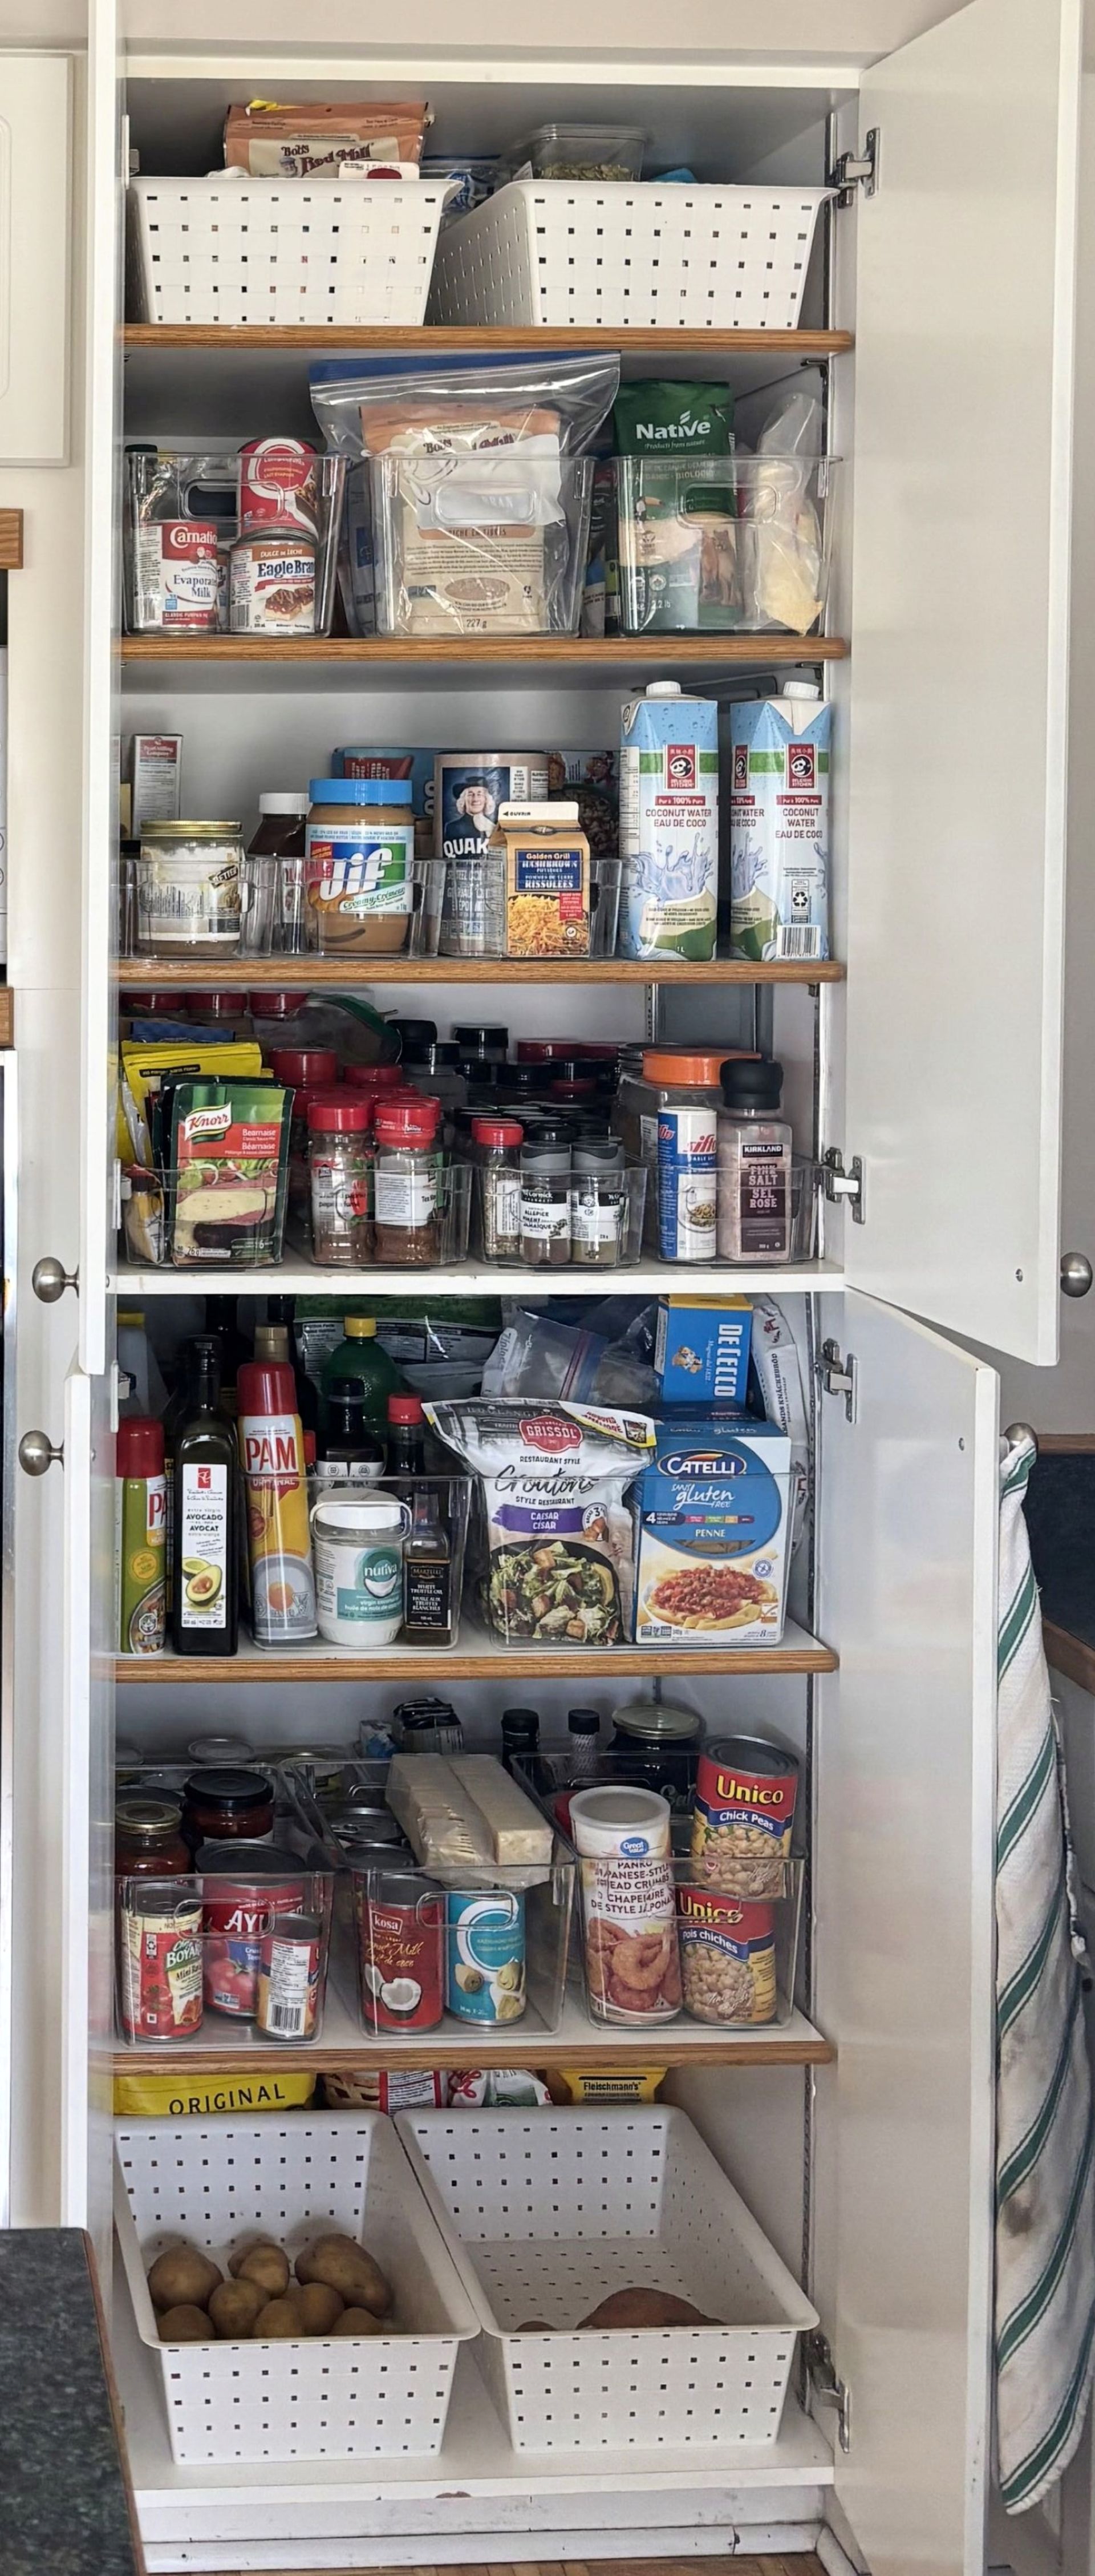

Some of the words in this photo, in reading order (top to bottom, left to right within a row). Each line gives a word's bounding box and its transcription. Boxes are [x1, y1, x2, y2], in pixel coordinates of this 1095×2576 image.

[281, 145, 309, 156] Bob's
[301, 153, 334, 176] Red
[336, 143, 373, 162] Mill
[636, 418, 711, 439] Native
[257, 562, 293, 579] Eagle
[192, 586, 212, 597] Milk
[467, 618, 480, 627] 227
[320, 848, 392, 900] Jif
[188, 1114, 229, 1131] Knorr
[749, 1175, 778, 1186] SALT
[752, 1188, 774, 1198] SEL
[749, 1199, 777, 1208] ROSE
[718, 1324, 743, 1345] DE
[714, 1348, 741, 1396] CECCO
[526, 1426, 578, 1439] GRISSOL
[245, 1437, 296, 1471] PAM
[667, 1457, 735, 1474] CATELLI
[516, 1496, 536, 1505] STYLE
[673, 1484, 735, 1511] gluten
[531, 1512, 559, 1520] CAESAR
[646, 1512, 655, 1523] 4
[716, 1774, 784, 1805] Unico
[719, 1810, 748, 1822] Chick
[751, 1813, 774, 1830] Peas
[606, 1904, 636, 1914] STYLE
[680, 1891, 744, 1924] Unico
[375, 1915, 398, 1930] kosa
[683, 1929, 697, 1940] pois
[699, 1930, 738, 1954] chiches
[583, 2081, 639, 2090] Fleischmann's
[169, 2083, 285, 2114] ORIGINAL
